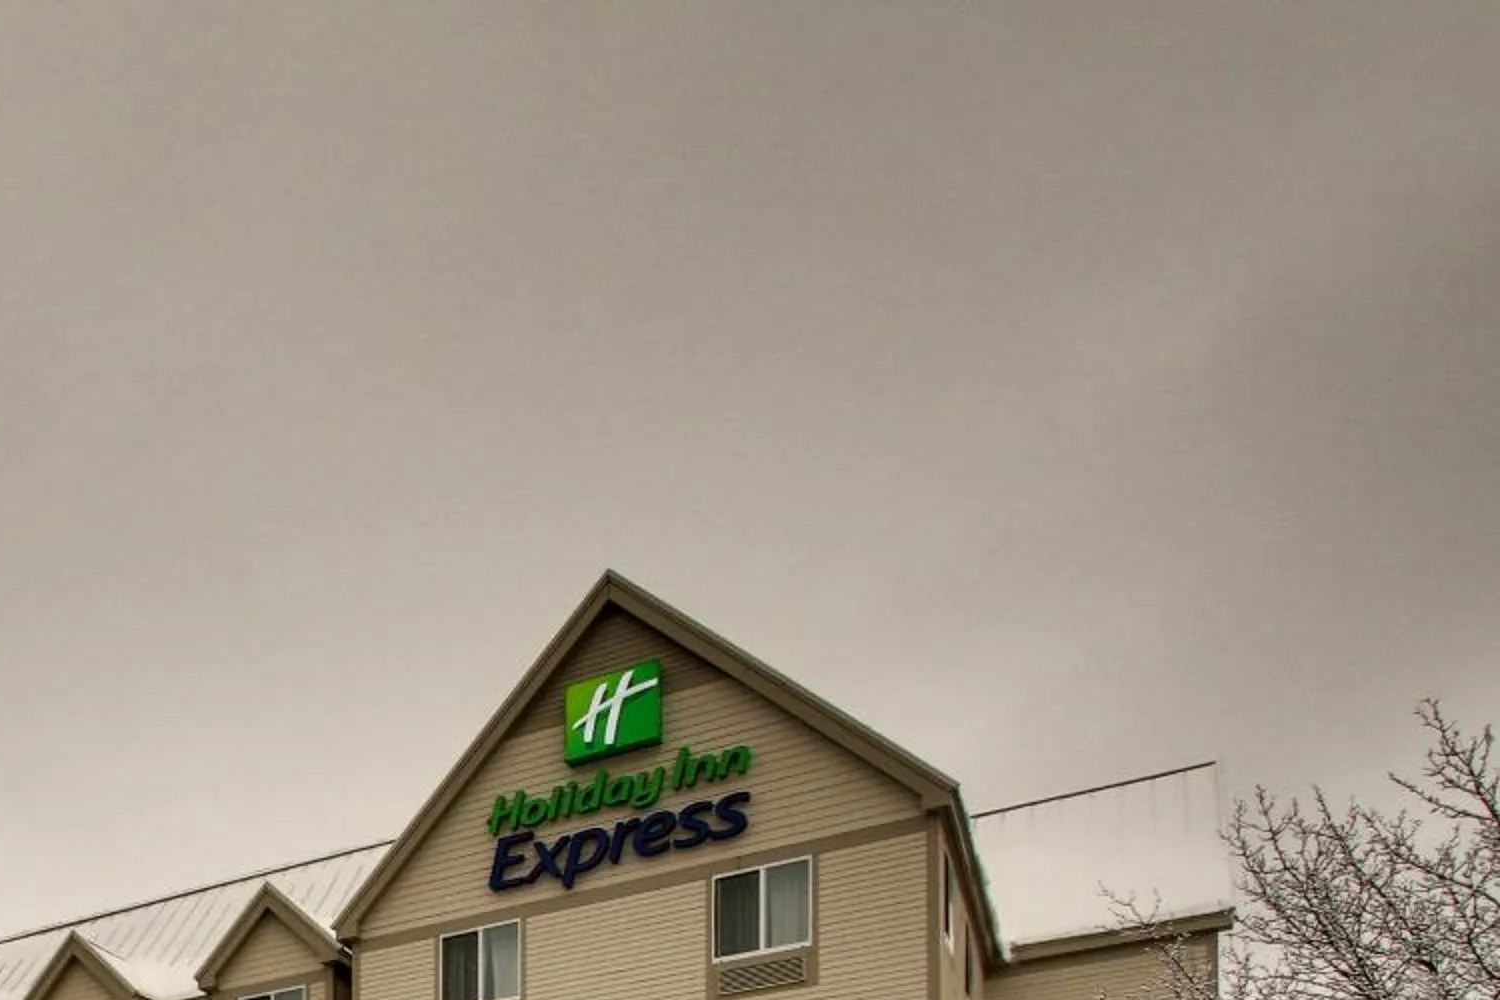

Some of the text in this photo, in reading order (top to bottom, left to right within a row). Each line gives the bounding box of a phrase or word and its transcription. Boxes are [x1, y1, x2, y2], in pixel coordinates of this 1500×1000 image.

[572, 670, 659, 744] H
[487, 744, 752, 836] Holiday Inn
[488, 790, 751, 892] Express
